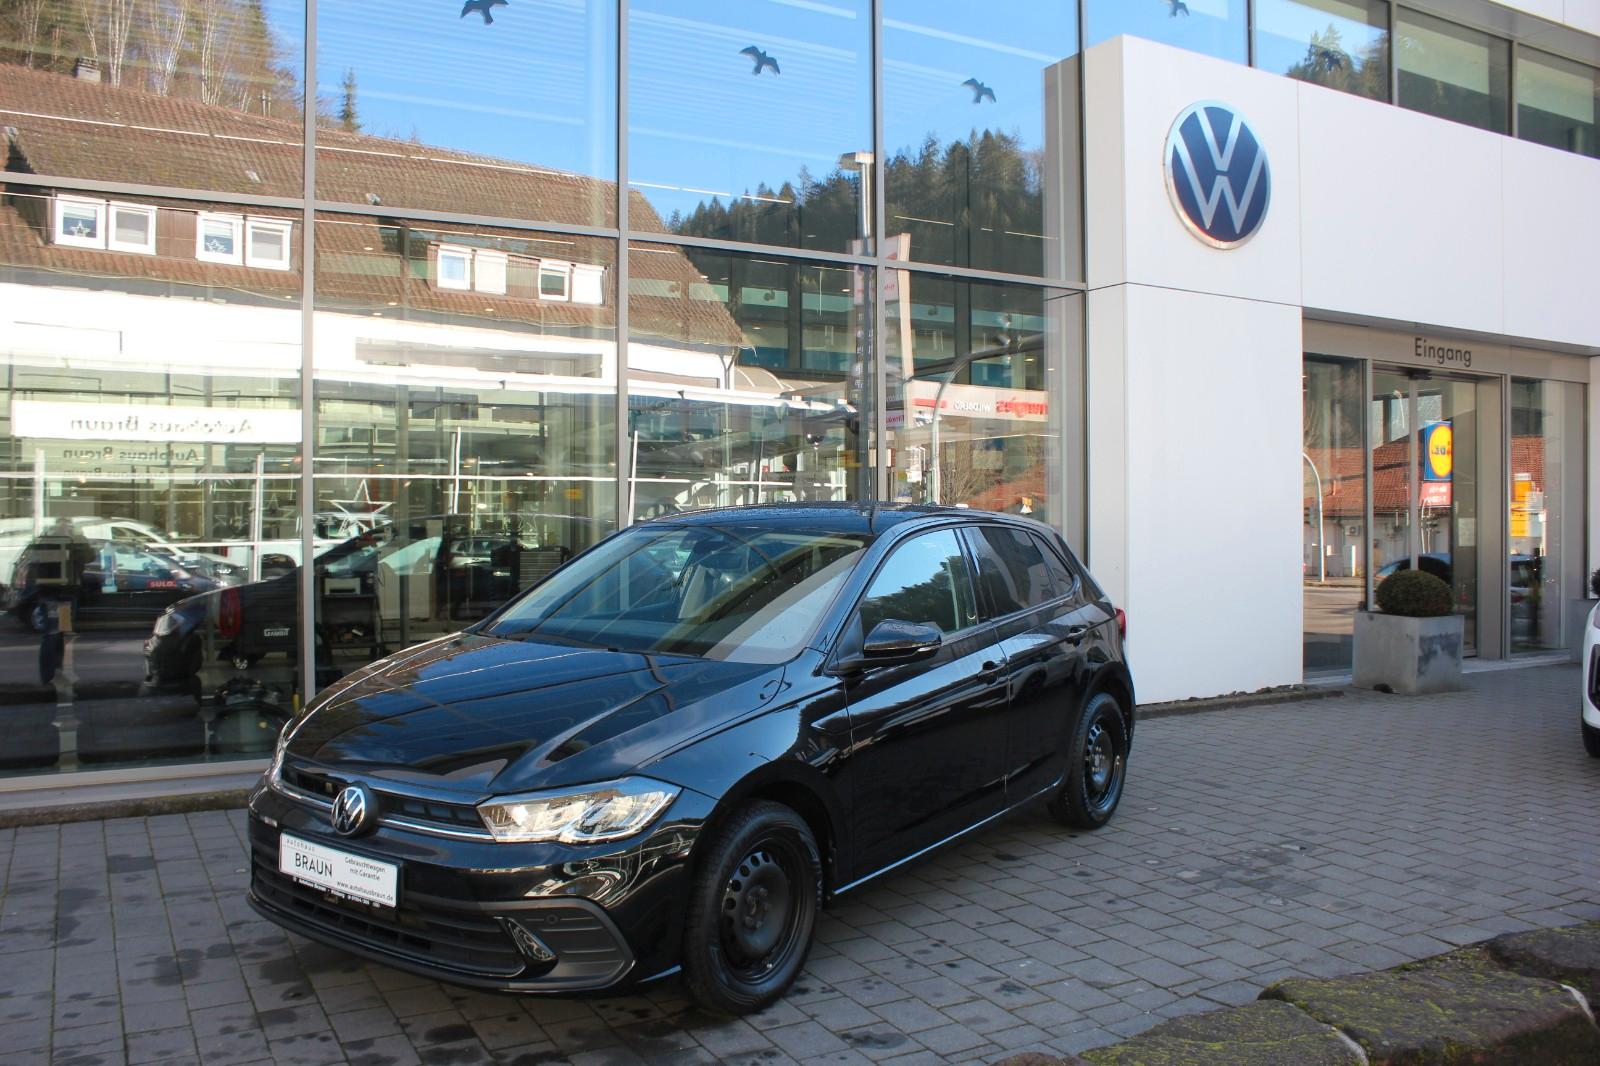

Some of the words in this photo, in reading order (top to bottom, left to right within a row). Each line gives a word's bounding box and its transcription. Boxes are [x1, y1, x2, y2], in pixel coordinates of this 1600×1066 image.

[1415, 337, 1471, 367] Eingang
[286, 838, 315, 852] autohaus
[295, 852, 333, 877] BRAUN
[344, 856, 386, 873] Gebrauchtwagen
[349, 867, 359, 876] mit
[359, 868, 380, 881] Garantie
[337, 881, 393, 901] www.autohausbraun.de
